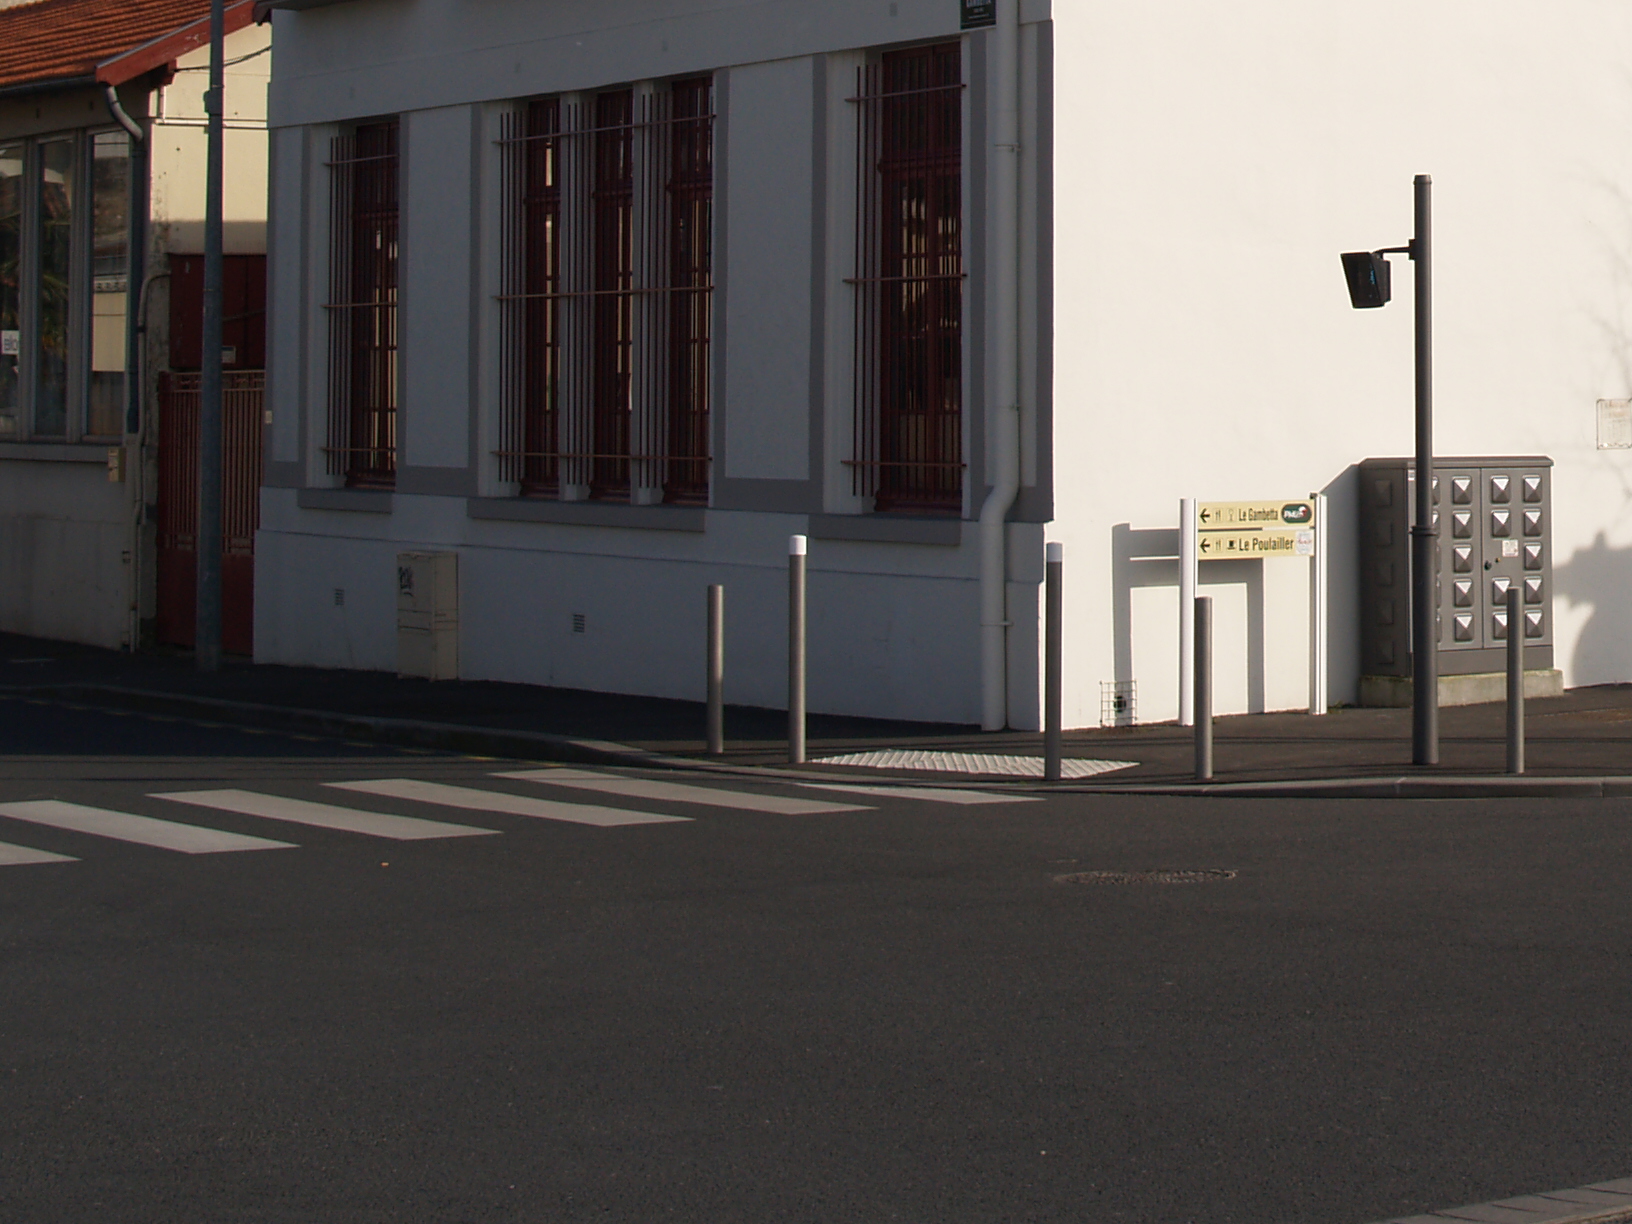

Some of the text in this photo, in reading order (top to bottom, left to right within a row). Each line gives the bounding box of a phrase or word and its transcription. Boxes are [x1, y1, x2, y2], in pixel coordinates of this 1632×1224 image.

[1238, 508, 1247, 521] Le
[1248, 508, 1279, 522] Gambetta
[1238, 538, 1250, 552] Le
[1252, 537, 1294, 552] Poulailler
